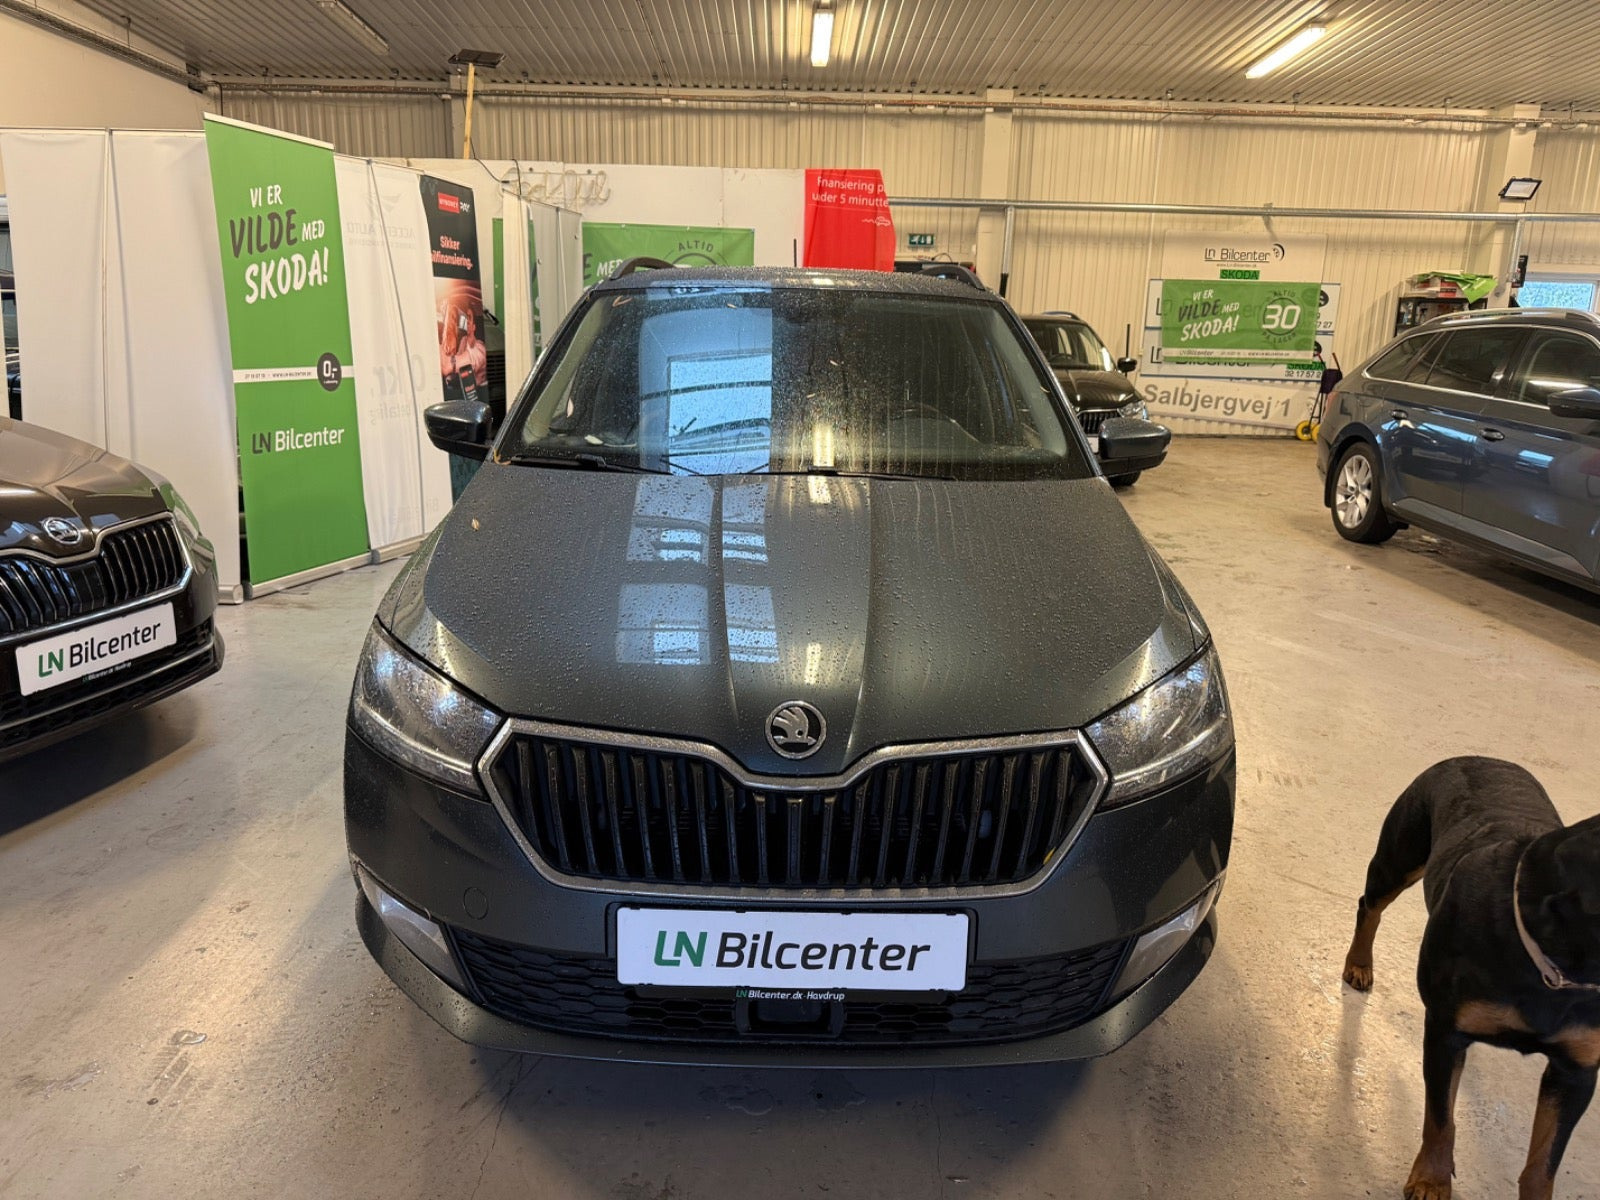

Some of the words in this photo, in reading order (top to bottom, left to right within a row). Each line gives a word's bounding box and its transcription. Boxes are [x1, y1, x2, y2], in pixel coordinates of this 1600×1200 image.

[250, 187, 262, 208] VI
[267, 184, 283, 205] ER
[840, 194, 846, 204] 5
[229, 208, 298, 258] VILDE
[302, 219, 325, 241] MED
[440, 235, 460, 250] Sikker
[678, 240, 714, 253] ALTID
[1220, 248, 1271, 261] Bilcenter
[245, 246, 329, 304] SKODA!
[1221, 270, 1259, 280] SKODA
[1193, 291, 1201, 301] VI
[1203, 289, 1214, 299] ER
[1179, 299, 1221, 322] VILDE
[1222, 302, 1240, 314] MED
[1262, 304, 1301, 329] 30
[1181, 314, 1240, 342] SKODA!
[1143, 384, 1272, 420] Salbjergvej
[1280, 398, 1291, 417] 1
[252, 432, 271, 454] LN
[275, 427, 345, 452] Bilcenter
[38, 648, 64, 678] LN
[69, 623, 161, 668] Bilcenter
[653, 930, 708, 967] LN
[715, 931, 931, 971] Bilcenter
[806, 991, 845, 1001] Havdrup
